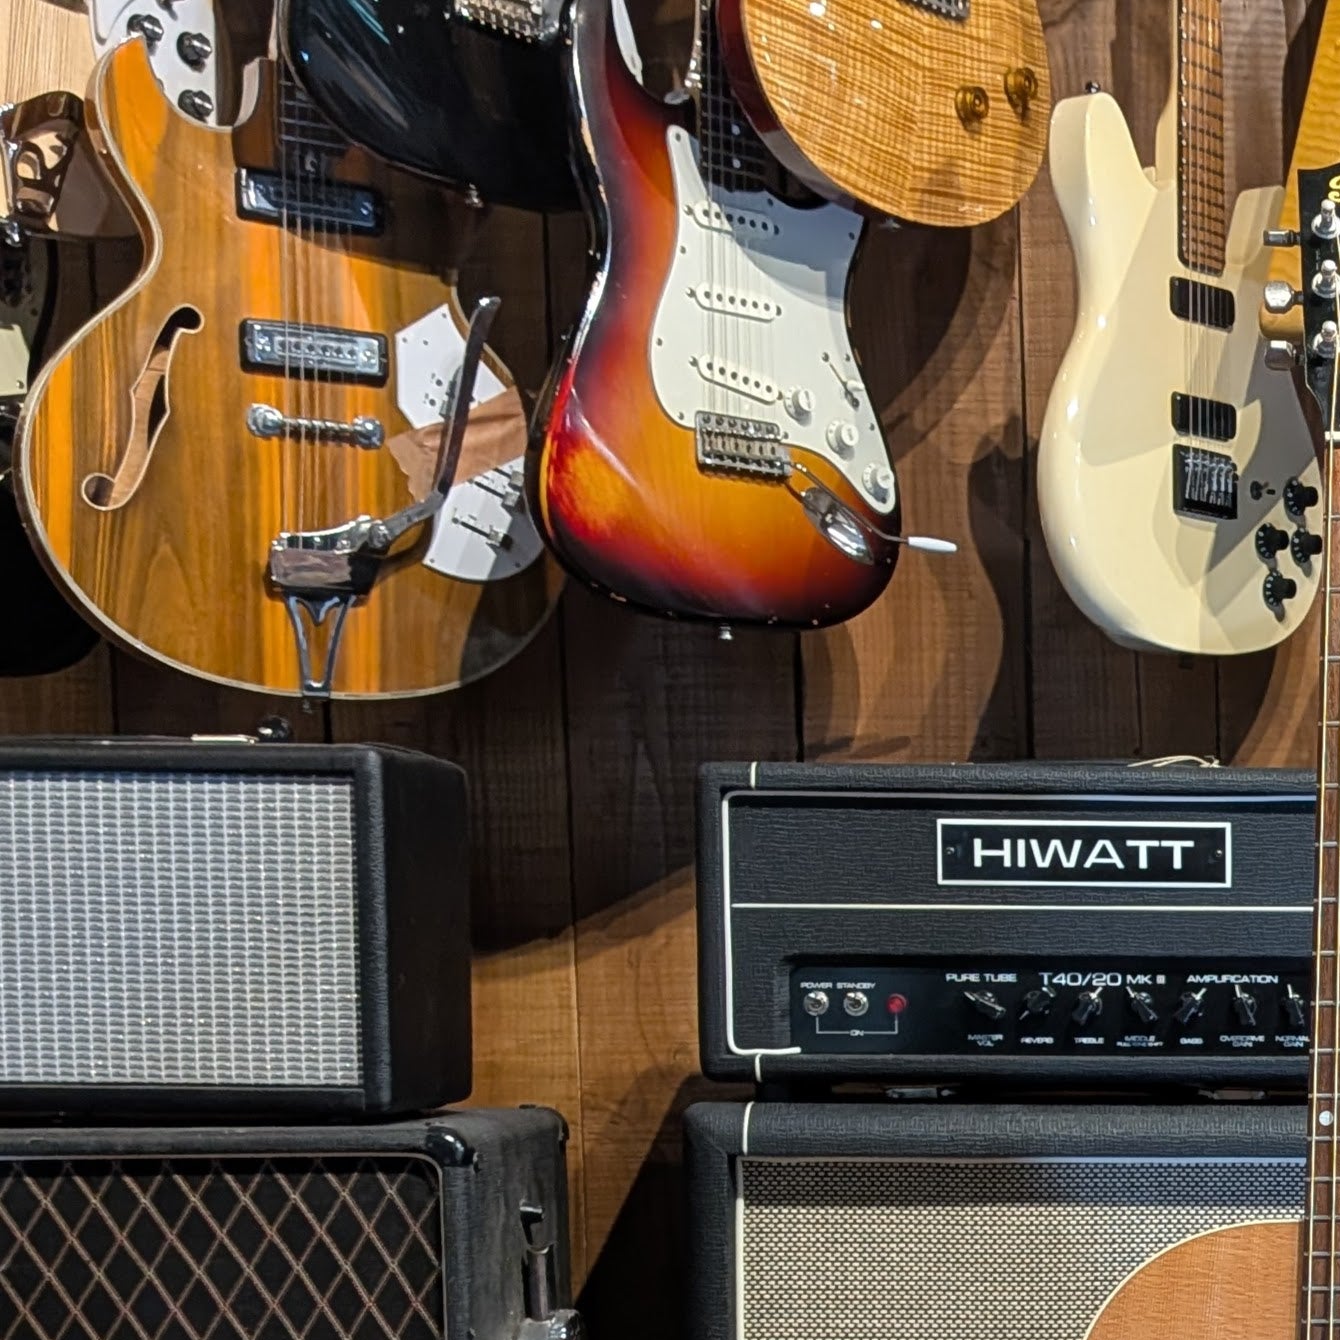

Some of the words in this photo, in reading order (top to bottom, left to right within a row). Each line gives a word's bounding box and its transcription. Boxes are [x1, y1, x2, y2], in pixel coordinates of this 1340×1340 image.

[973, 838, 1195, 870] HIWATT
[945, 973, 981, 983] PURE
[984, 973, 1018, 983] TUBE
[1038, 972, 1122, 987] T40/20
[1126, 975, 1153, 985] MK
[1186, 974, 1279, 984] AMPLIFICATION
[836, 982, 876, 990] STANDBY
[851, 1029, 864, 1037] ON
